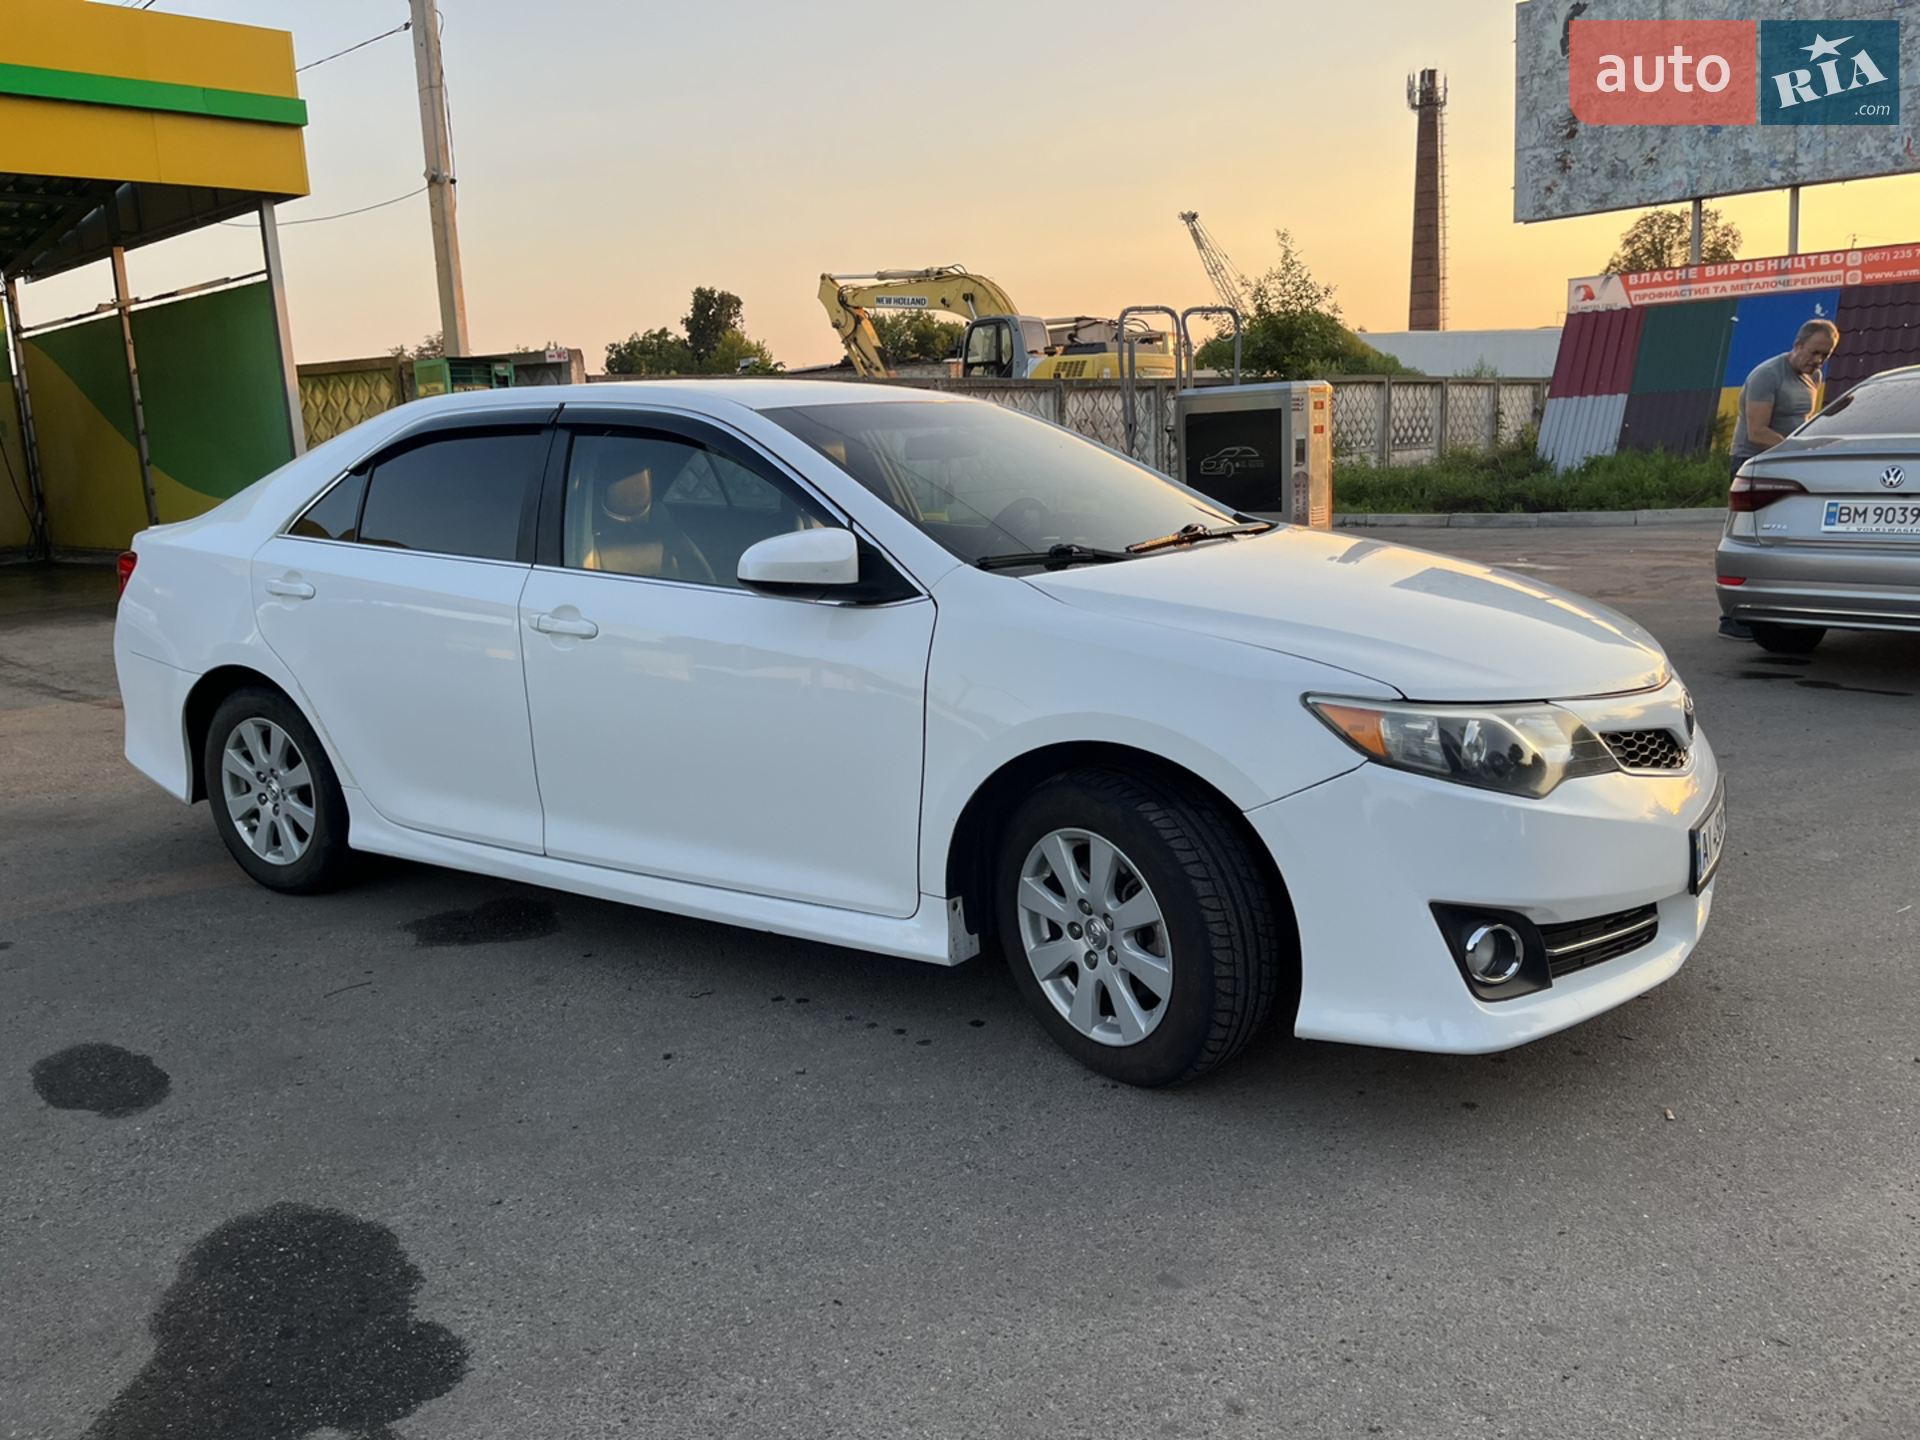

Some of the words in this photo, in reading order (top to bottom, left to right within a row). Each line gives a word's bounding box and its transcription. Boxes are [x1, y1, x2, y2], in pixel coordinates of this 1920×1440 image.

[1863, 251, 1891, 263] (067)
[1892, 249, 1912, 260] 235
[1628, 266, 1698, 285] ВЛАСНЕ
[1704, 252, 1844, 278] ВИРОБНИЦТВО
[1633, 286, 1710, 302] ПРОФНАСТИЛ
[1713, 285, 1727, 294] ТА
[1730, 273, 1843, 292] МЕТАЛОЧЕРЕПИЦЯ
[876, 296, 892, 305] NEW
[893, 297, 926, 306] HOLLAND
[556, 350, 567, 360] WC
[1838, 506, 1868, 524] BM
[1873, 506, 1920, 525] 9039
